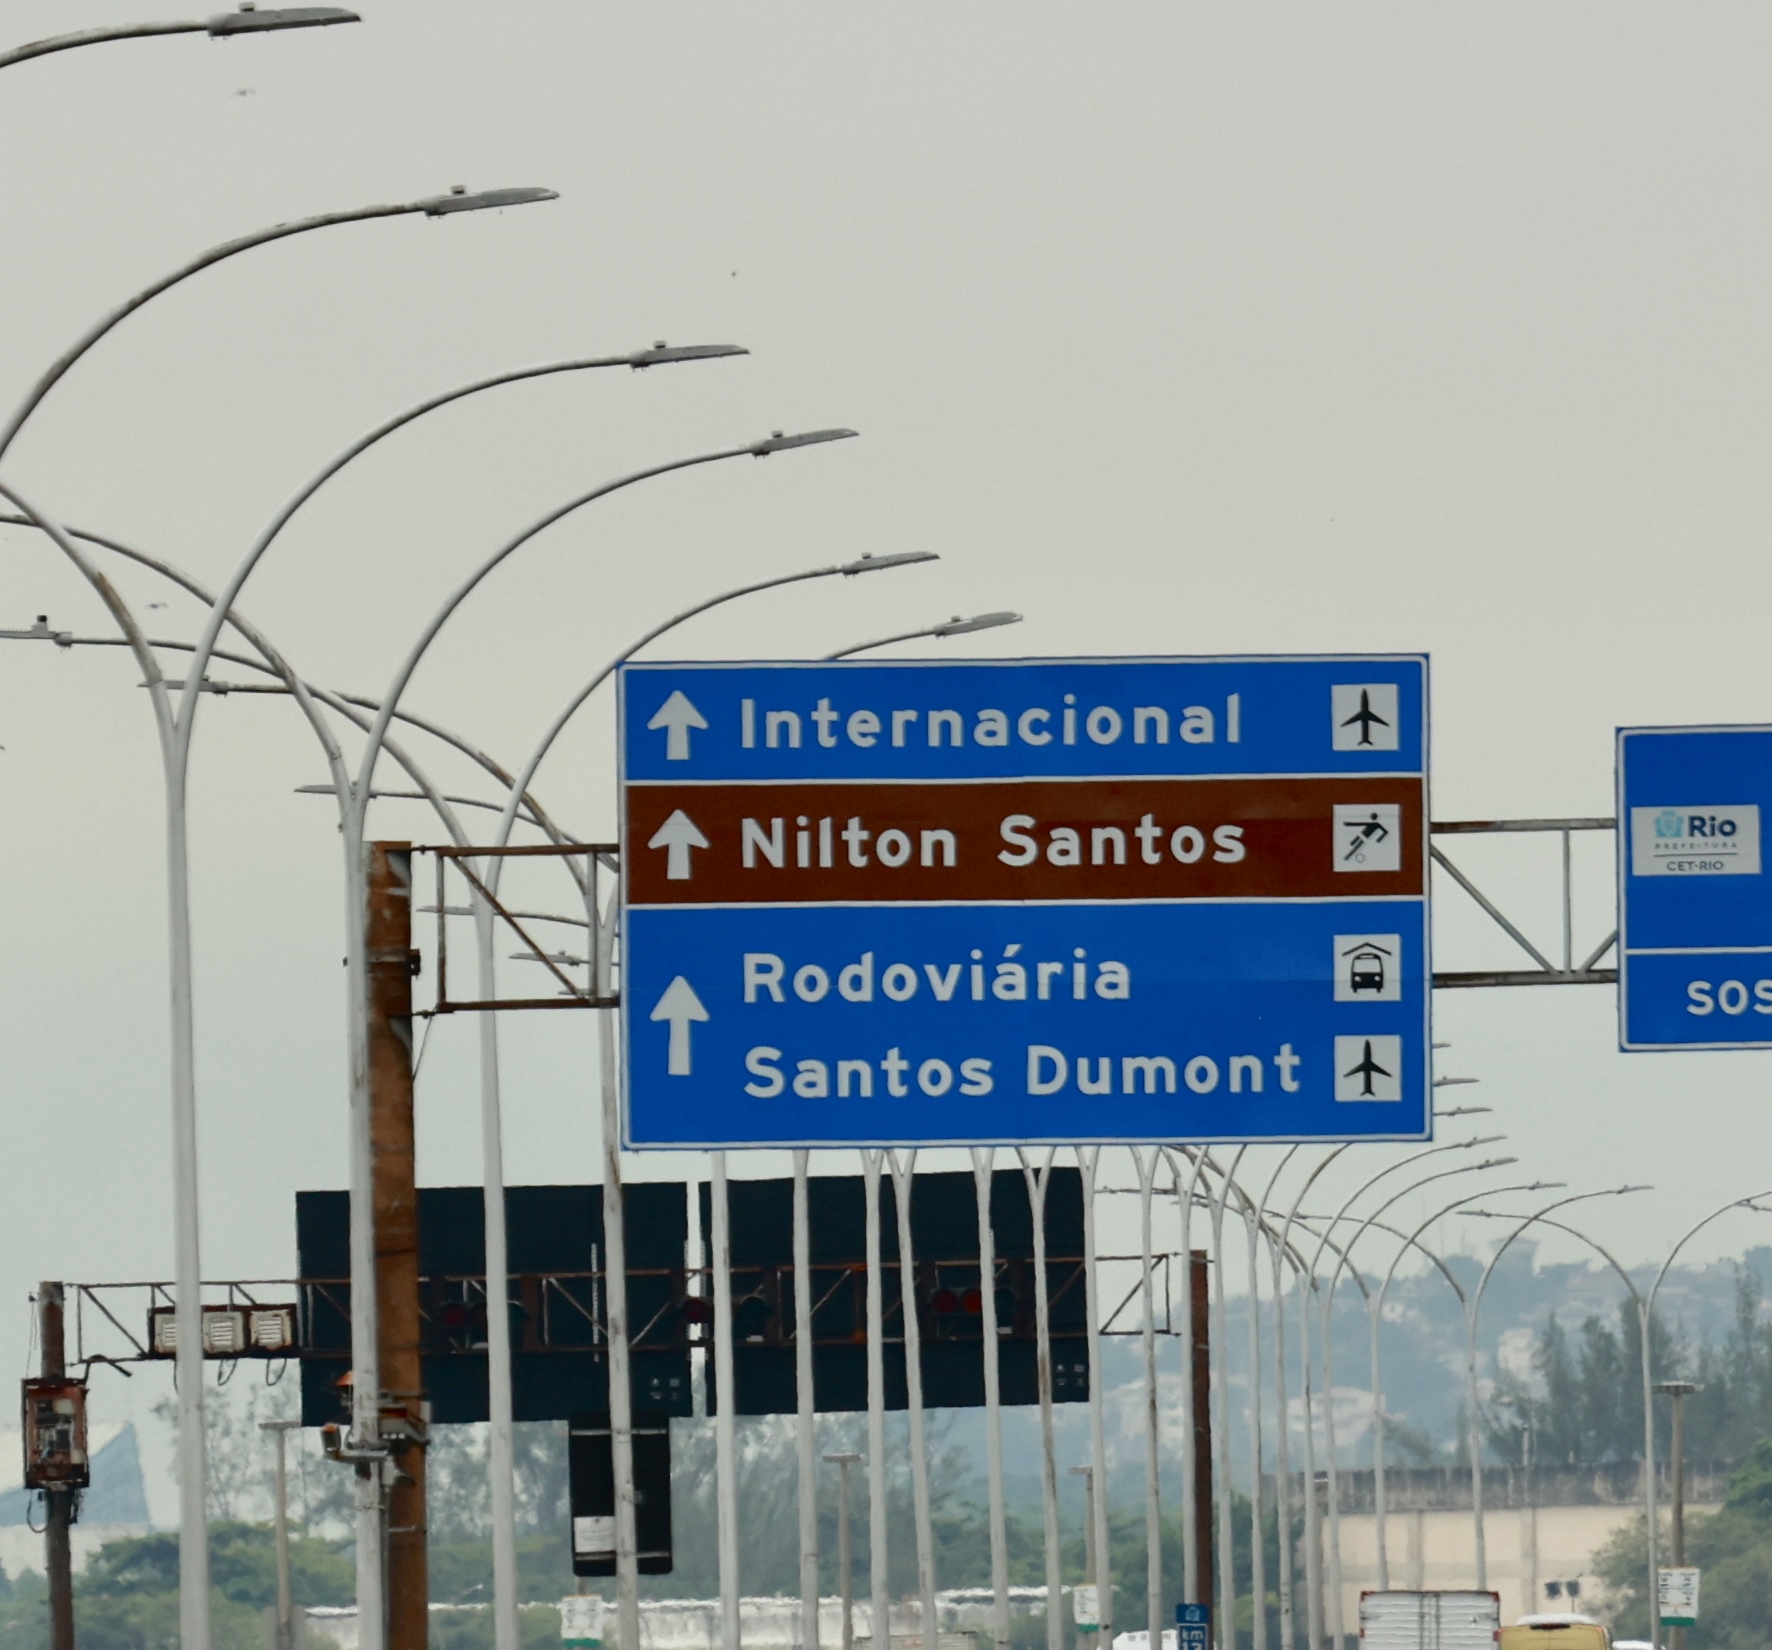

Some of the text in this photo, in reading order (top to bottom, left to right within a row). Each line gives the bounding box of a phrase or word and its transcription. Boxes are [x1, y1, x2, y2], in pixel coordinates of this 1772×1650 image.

[741, 692, 1241, 749] Internacional
[741, 813, 1246, 869] Nilton Santos
[1688, 815, 1738, 838] Rio
[1666, 860, 1725, 872] CET-RIO
[743, 943, 1131, 1004] Rodoviária
[743, 1042, 1301, 1099] Santos Dumont
[1182, 1629, 1203, 1640] km
